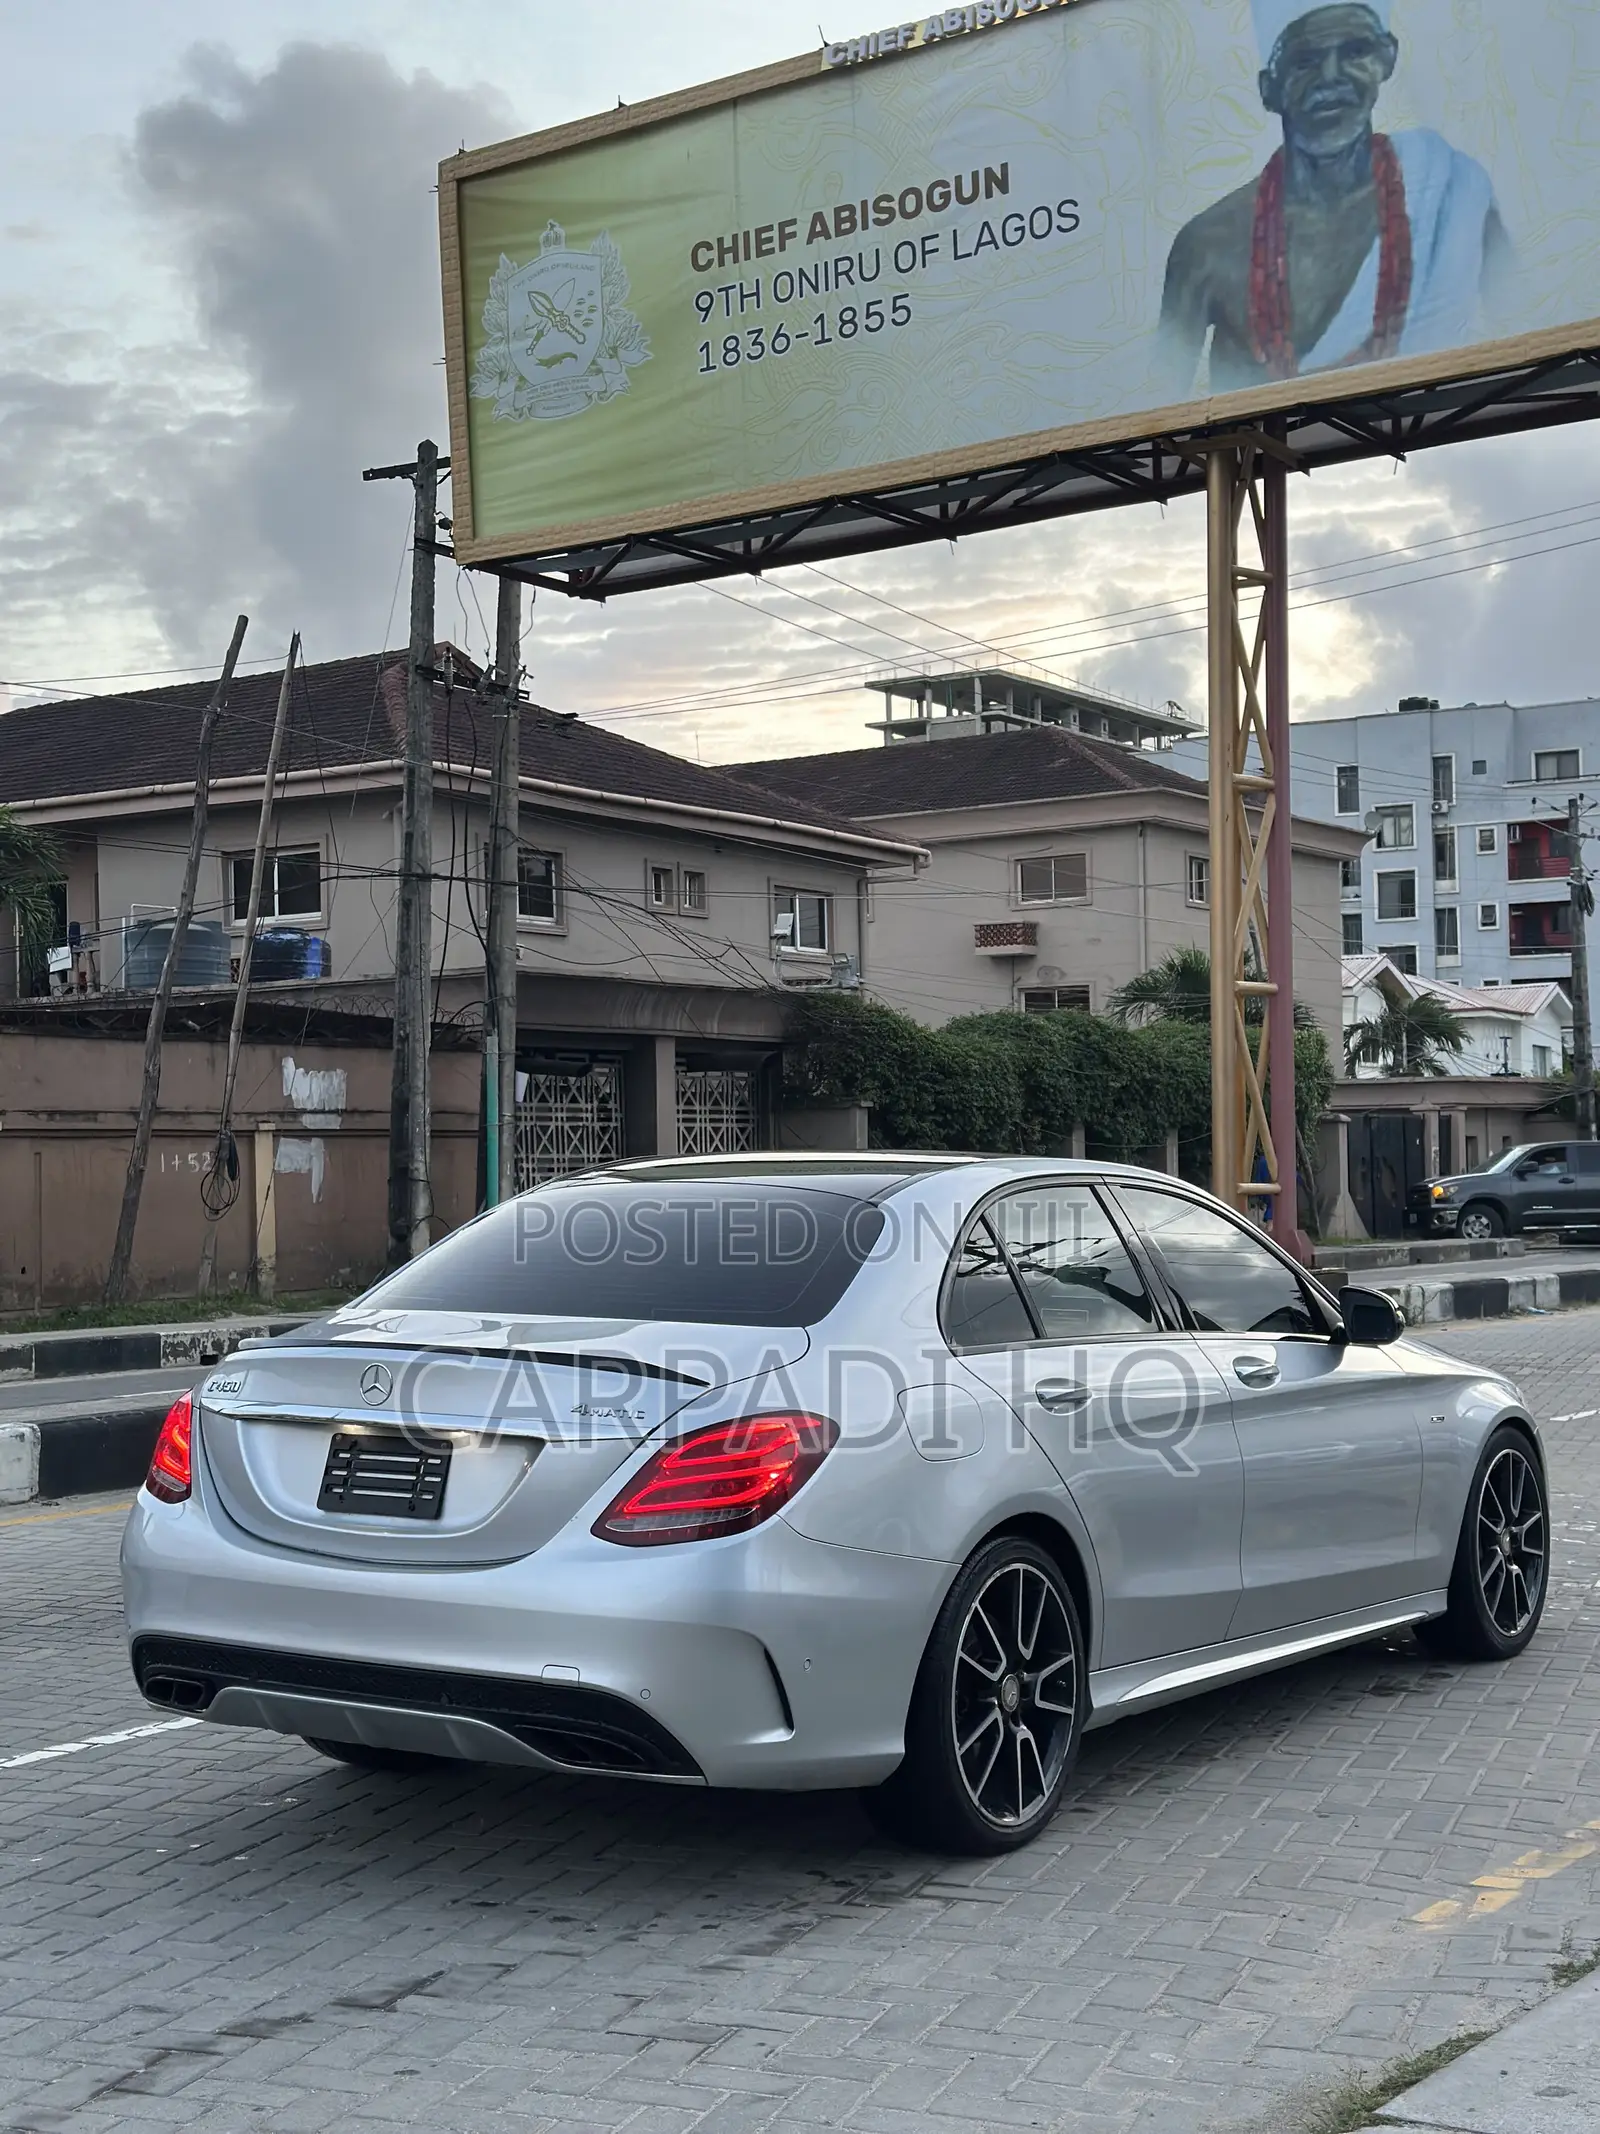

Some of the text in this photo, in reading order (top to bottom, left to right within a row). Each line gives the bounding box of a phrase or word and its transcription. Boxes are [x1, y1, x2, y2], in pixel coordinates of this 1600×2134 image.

[826, 0, 1076, 67] CHIEF ABISO
[691, 162, 1010, 272] CHIEF ABISOGUN
[694, 198, 1081, 323] 9TH ONIRU OF LAGOS
[698, 292, 912, 373] 1836-1855
[207, 1379, 242, 1393] C450
[570, 1403, 646, 1420] 4MATIC
